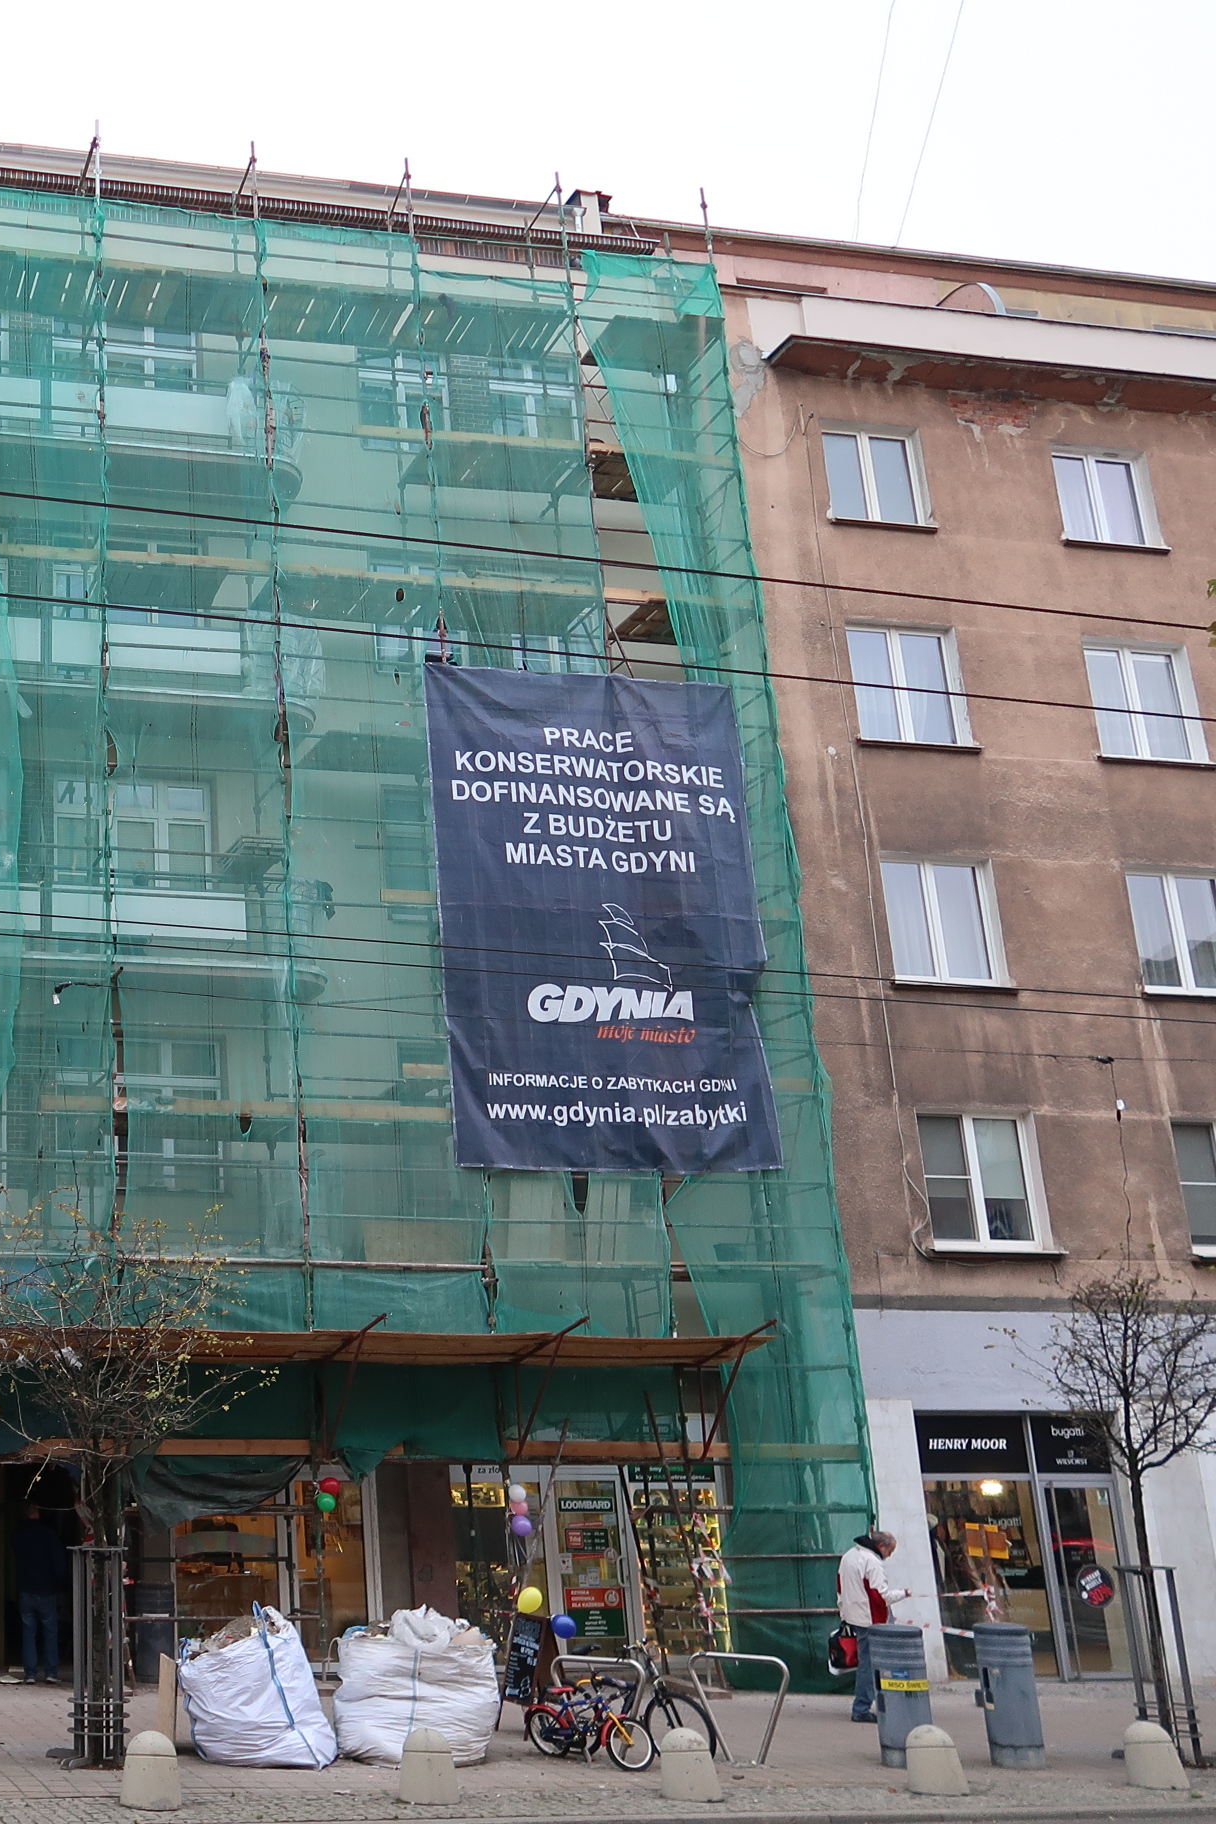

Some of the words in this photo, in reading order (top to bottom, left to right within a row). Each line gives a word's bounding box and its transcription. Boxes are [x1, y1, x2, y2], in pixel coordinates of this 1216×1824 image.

[544, 727, 634, 754] PRACE
[454, 750, 725, 789] KONSERWATORSKIE
[451, 779, 691, 813] DOFINANSOWANE
[698, 794, 736, 824] SĄ
[523, 812, 542, 834] Z
[548, 814, 672, 843] BUDŻETU
[505, 842, 608, 870] MIASTA
[611, 850, 696, 874] GDYNI
[527, 983, 695, 1023] GDYNIA
[597, 1022, 637, 1043] moje
[640, 1025, 696, 1044] miasto
[488, 1072, 588, 1089] INFORMACJE
[591, 1076, 603, 1090] O
[606, 1077, 696, 1094] ZABYTKACH
[487, 1101, 748, 1130] www.gdynia.pl/zabytki
[928, 1438, 968, 1450] HENRY
[970, 1438, 1007, 1450] MOOR
[561, 1500, 611, 1510] LOOMBARD
[988, 1516, 1022, 1529] bugatti
